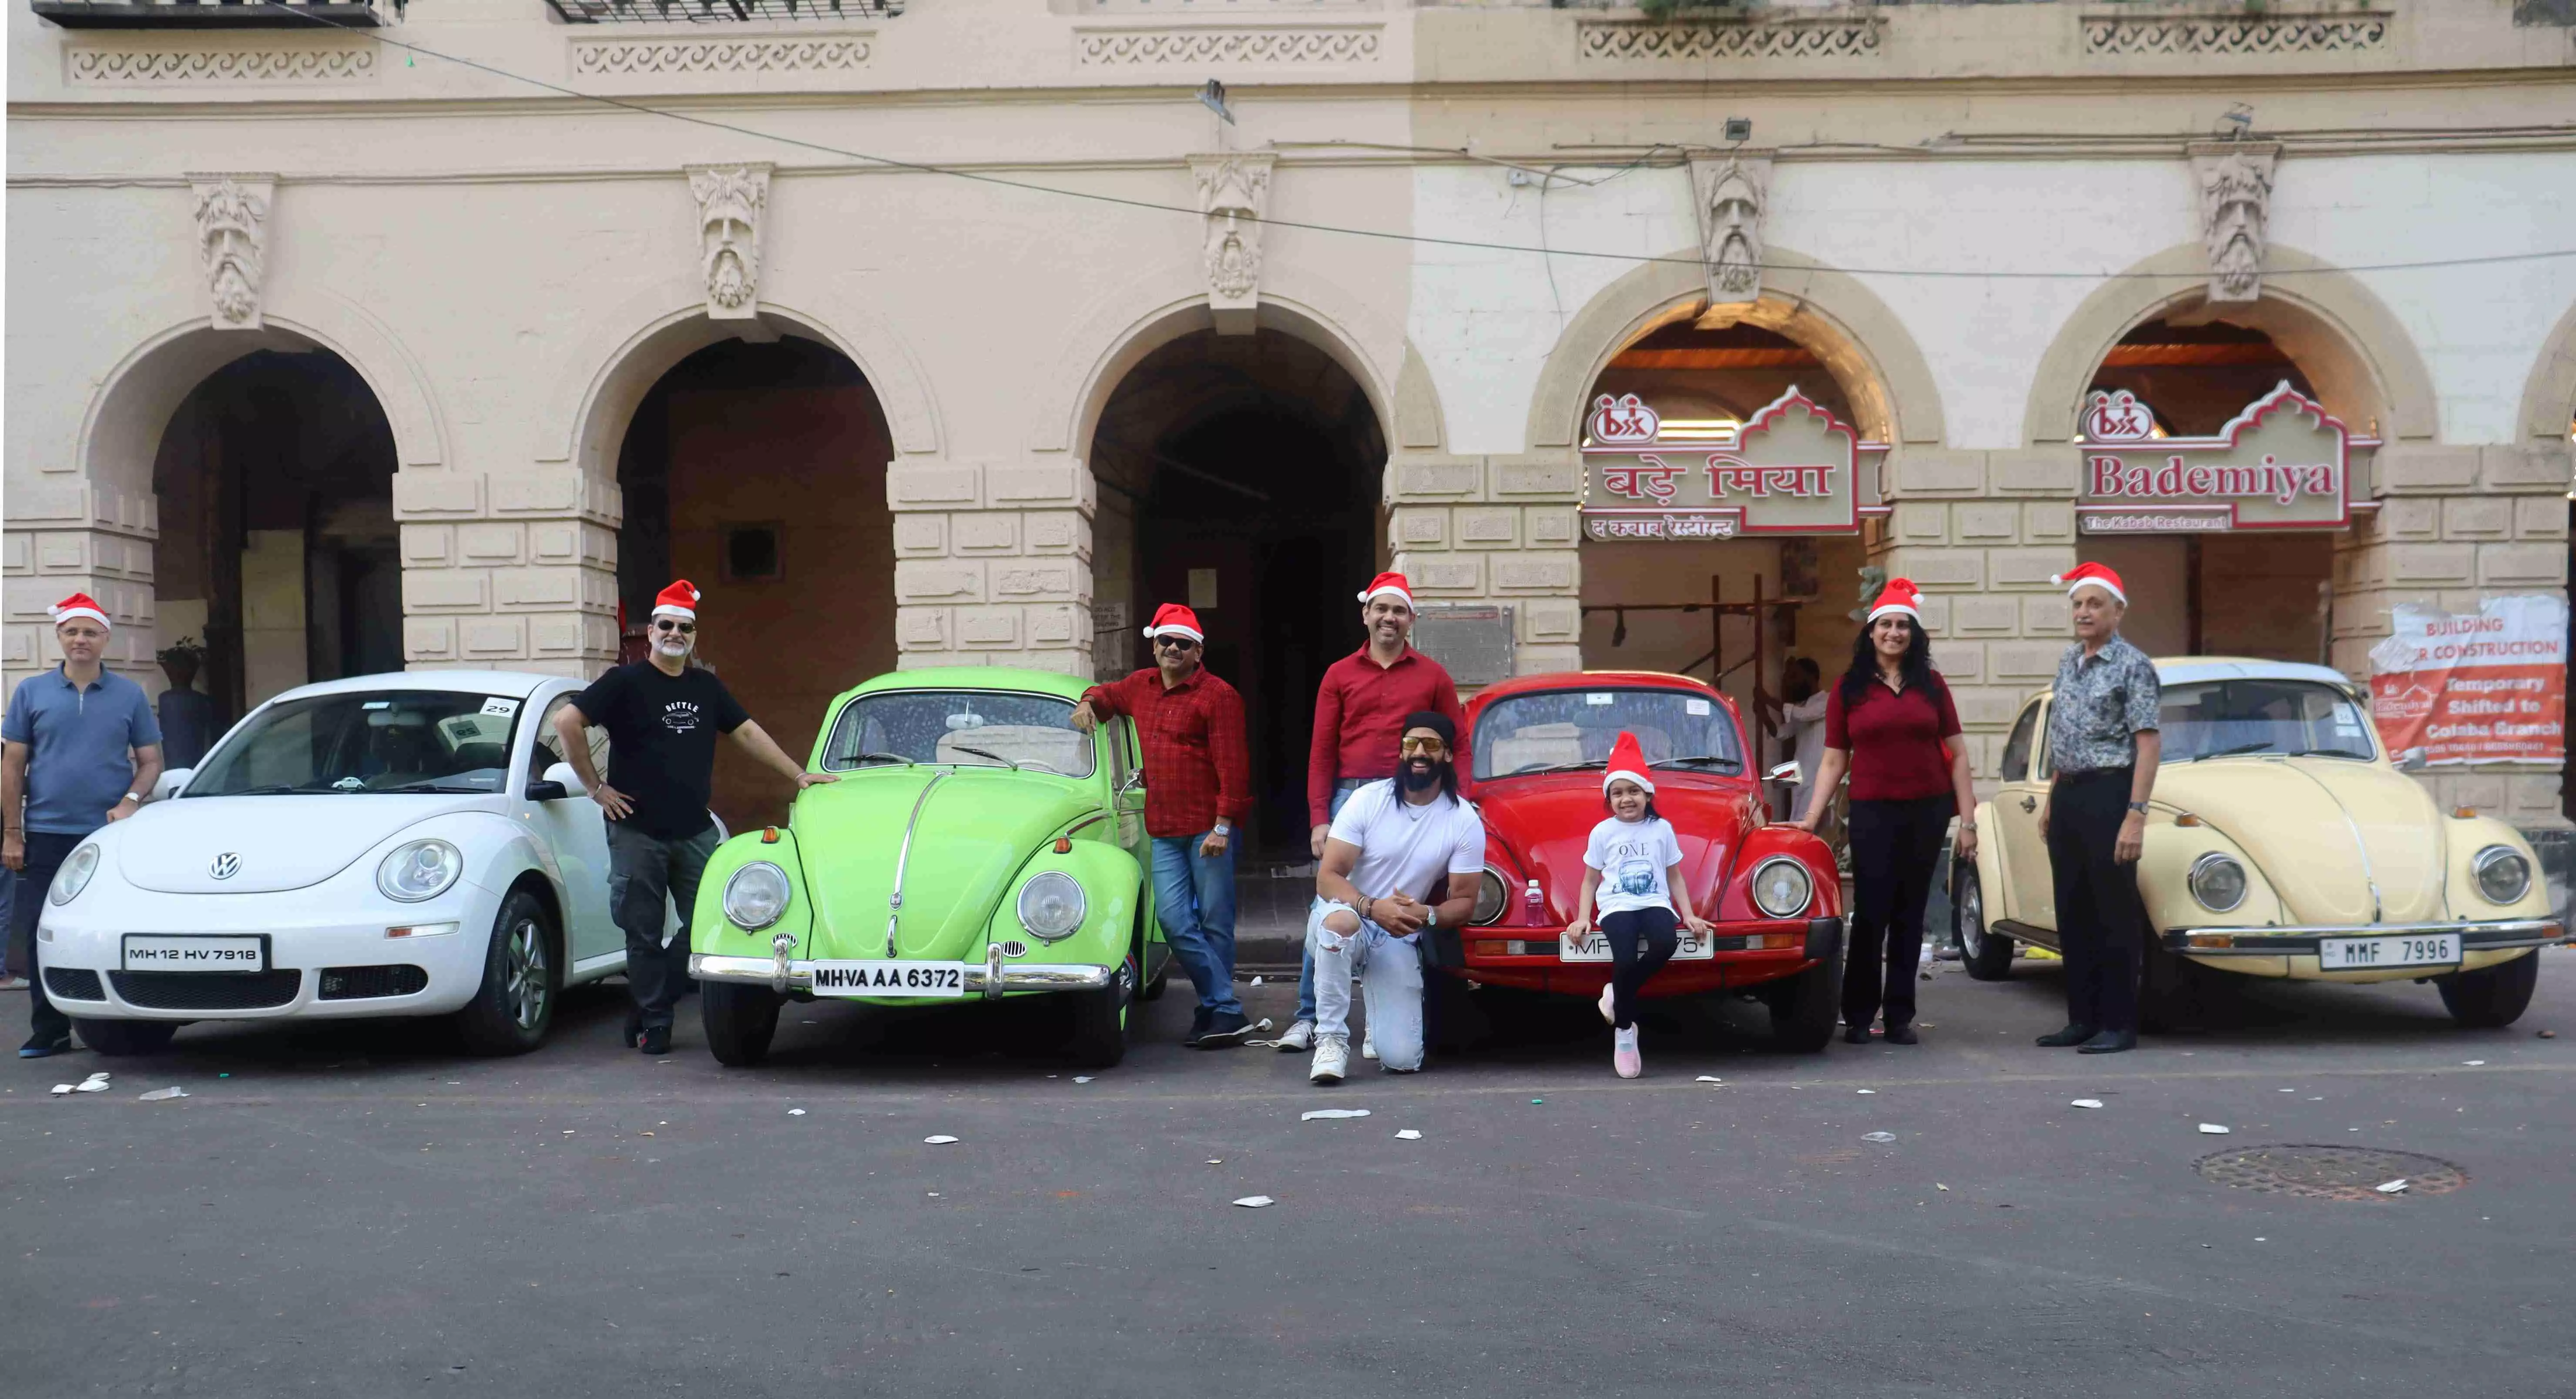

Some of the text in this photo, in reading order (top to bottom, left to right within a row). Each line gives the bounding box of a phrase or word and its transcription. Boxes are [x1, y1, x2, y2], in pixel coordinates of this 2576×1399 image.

[1603, 454, 1835, 506] बड़े मिया
[2088, 455, 2336, 504] Bademiya
[1591, 520, 1606, 537] द
[1608, 520, 1664, 538] कबाब
[2086, 516, 2227, 529] The Kabab Restaurant
[2426, 618, 2504, 636] BUILDING
[2434, 641, 2558, 659] CONSTRUCTION
[2446, 678, 2544, 694] Temporary
[2448, 699, 2540, 714] Shifted to
[2494, 720, 2561, 735] Branch
[1619, 843, 1649, 857] ONE
[130, 949, 257, 960] MH 12 HV 7918
[2345, 939, 2449, 963] MMF 7996
[907, 969, 959, 987] 6372
